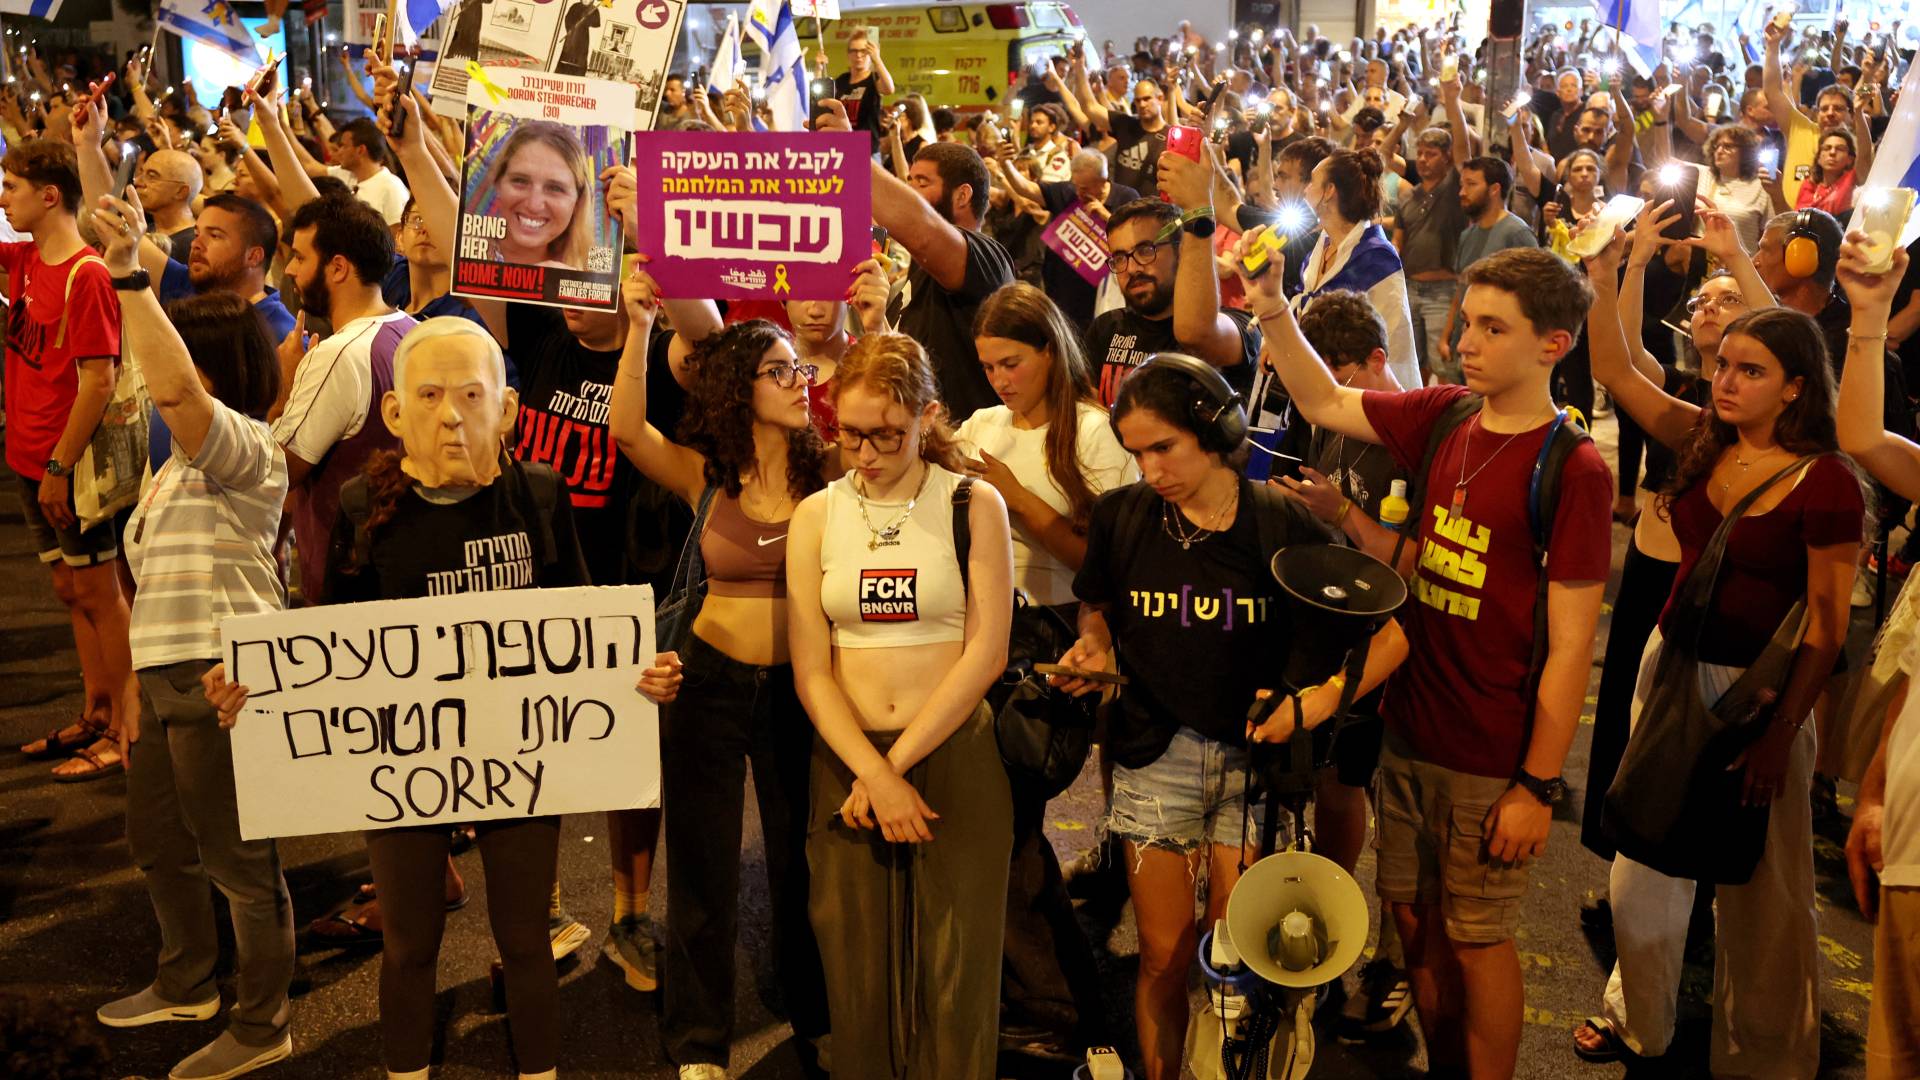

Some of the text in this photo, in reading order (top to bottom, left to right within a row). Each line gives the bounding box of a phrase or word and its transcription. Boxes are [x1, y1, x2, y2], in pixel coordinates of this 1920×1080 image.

[954, 56, 987, 70] ירקון
[507, 87, 597, 110] DORON STEINBRECHER
[566, 81, 586, 95] דורון
[958, 76, 981, 95] 1716
[543, 104, 560, 120] (30)
[661, 147, 845, 175] לקבל את העסקה
[662, 174, 845, 195] לעצור את המלחמה
[462, 213, 507, 240] BRING
[674, 208, 831, 254] עכשיו
[459, 235, 489, 260] HER
[1061, 223, 1103, 265] עכשיו
[458, 261, 545, 292] HOME NOW!
[559, 286, 611, 302] FAMILIES FORUM
[1110, 333, 1137, 349] BRING
[1106, 348, 1128, 363] THEM
[548, 389, 590, 422] הביתה
[464, 531, 532, 568] מחזירים
[426, 558, 533, 597] אותם הביתה
[861, 577, 914, 599] FCK
[861, 601, 914, 614] BNGVR
[1129, 584, 1275, 632] ור[ש]ינוי
[232, 614, 642, 698] הוספתי סעיפים
[283, 694, 616, 759] מתו חטופים
[366, 755, 545, 823] SORRY
